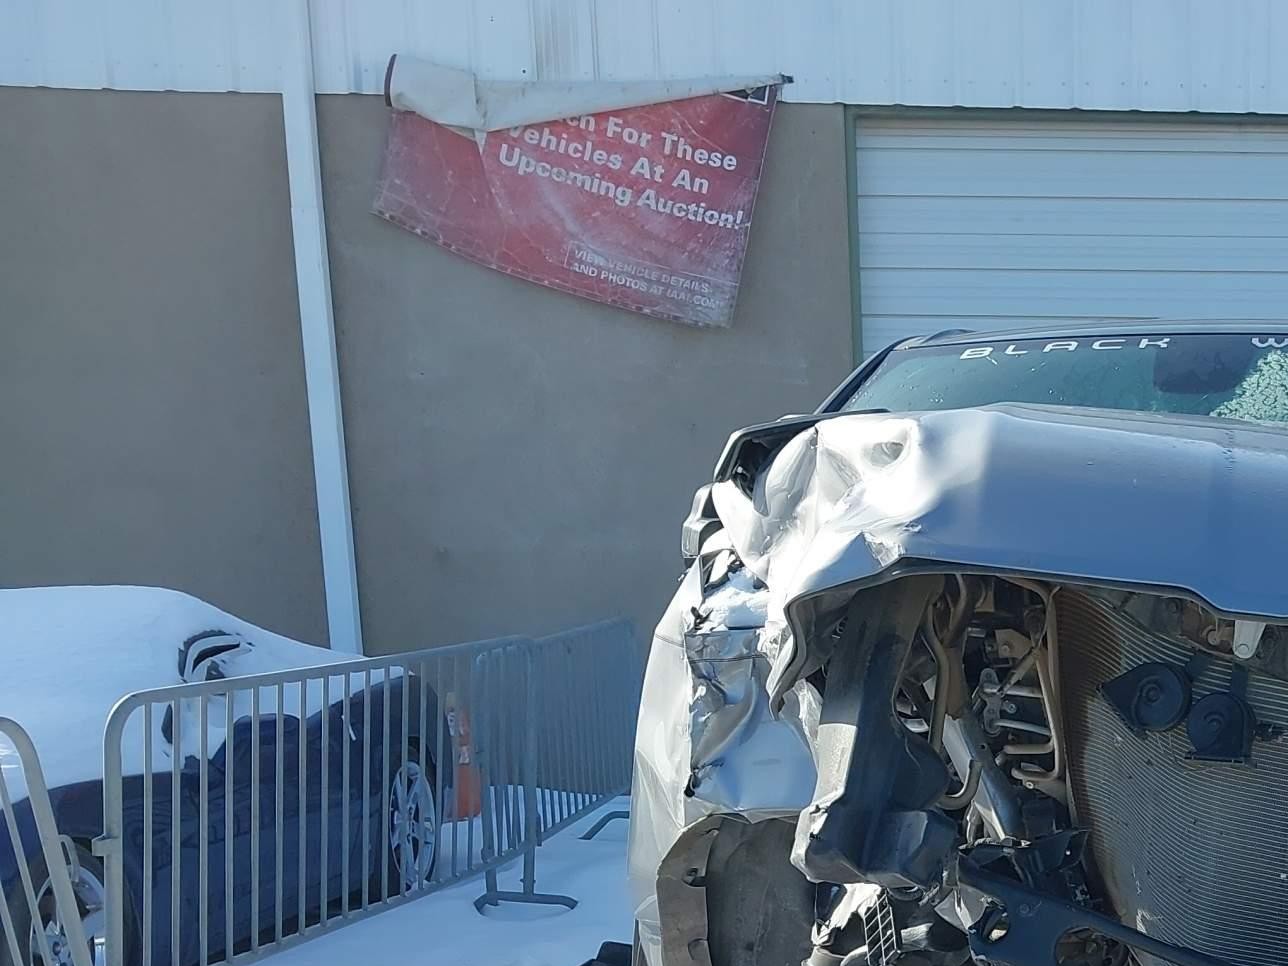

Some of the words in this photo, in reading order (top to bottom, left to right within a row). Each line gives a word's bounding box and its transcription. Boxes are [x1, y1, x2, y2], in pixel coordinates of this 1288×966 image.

[606, 116, 653, 149] For
[660, 131, 738, 172] These
[499, 143, 633, 208] Upcoming
[637, 187, 744, 231] Auction!
[630, 157, 665, 183] At
[671, 168, 709, 195] An
[571, 262, 597, 278] AND
[600, 270, 649, 292] PHOTOS
[650, 286, 664, 297] AT
[608, 258, 659, 282] VEHICLE
[959, 337, 1171, 360] BLACK
